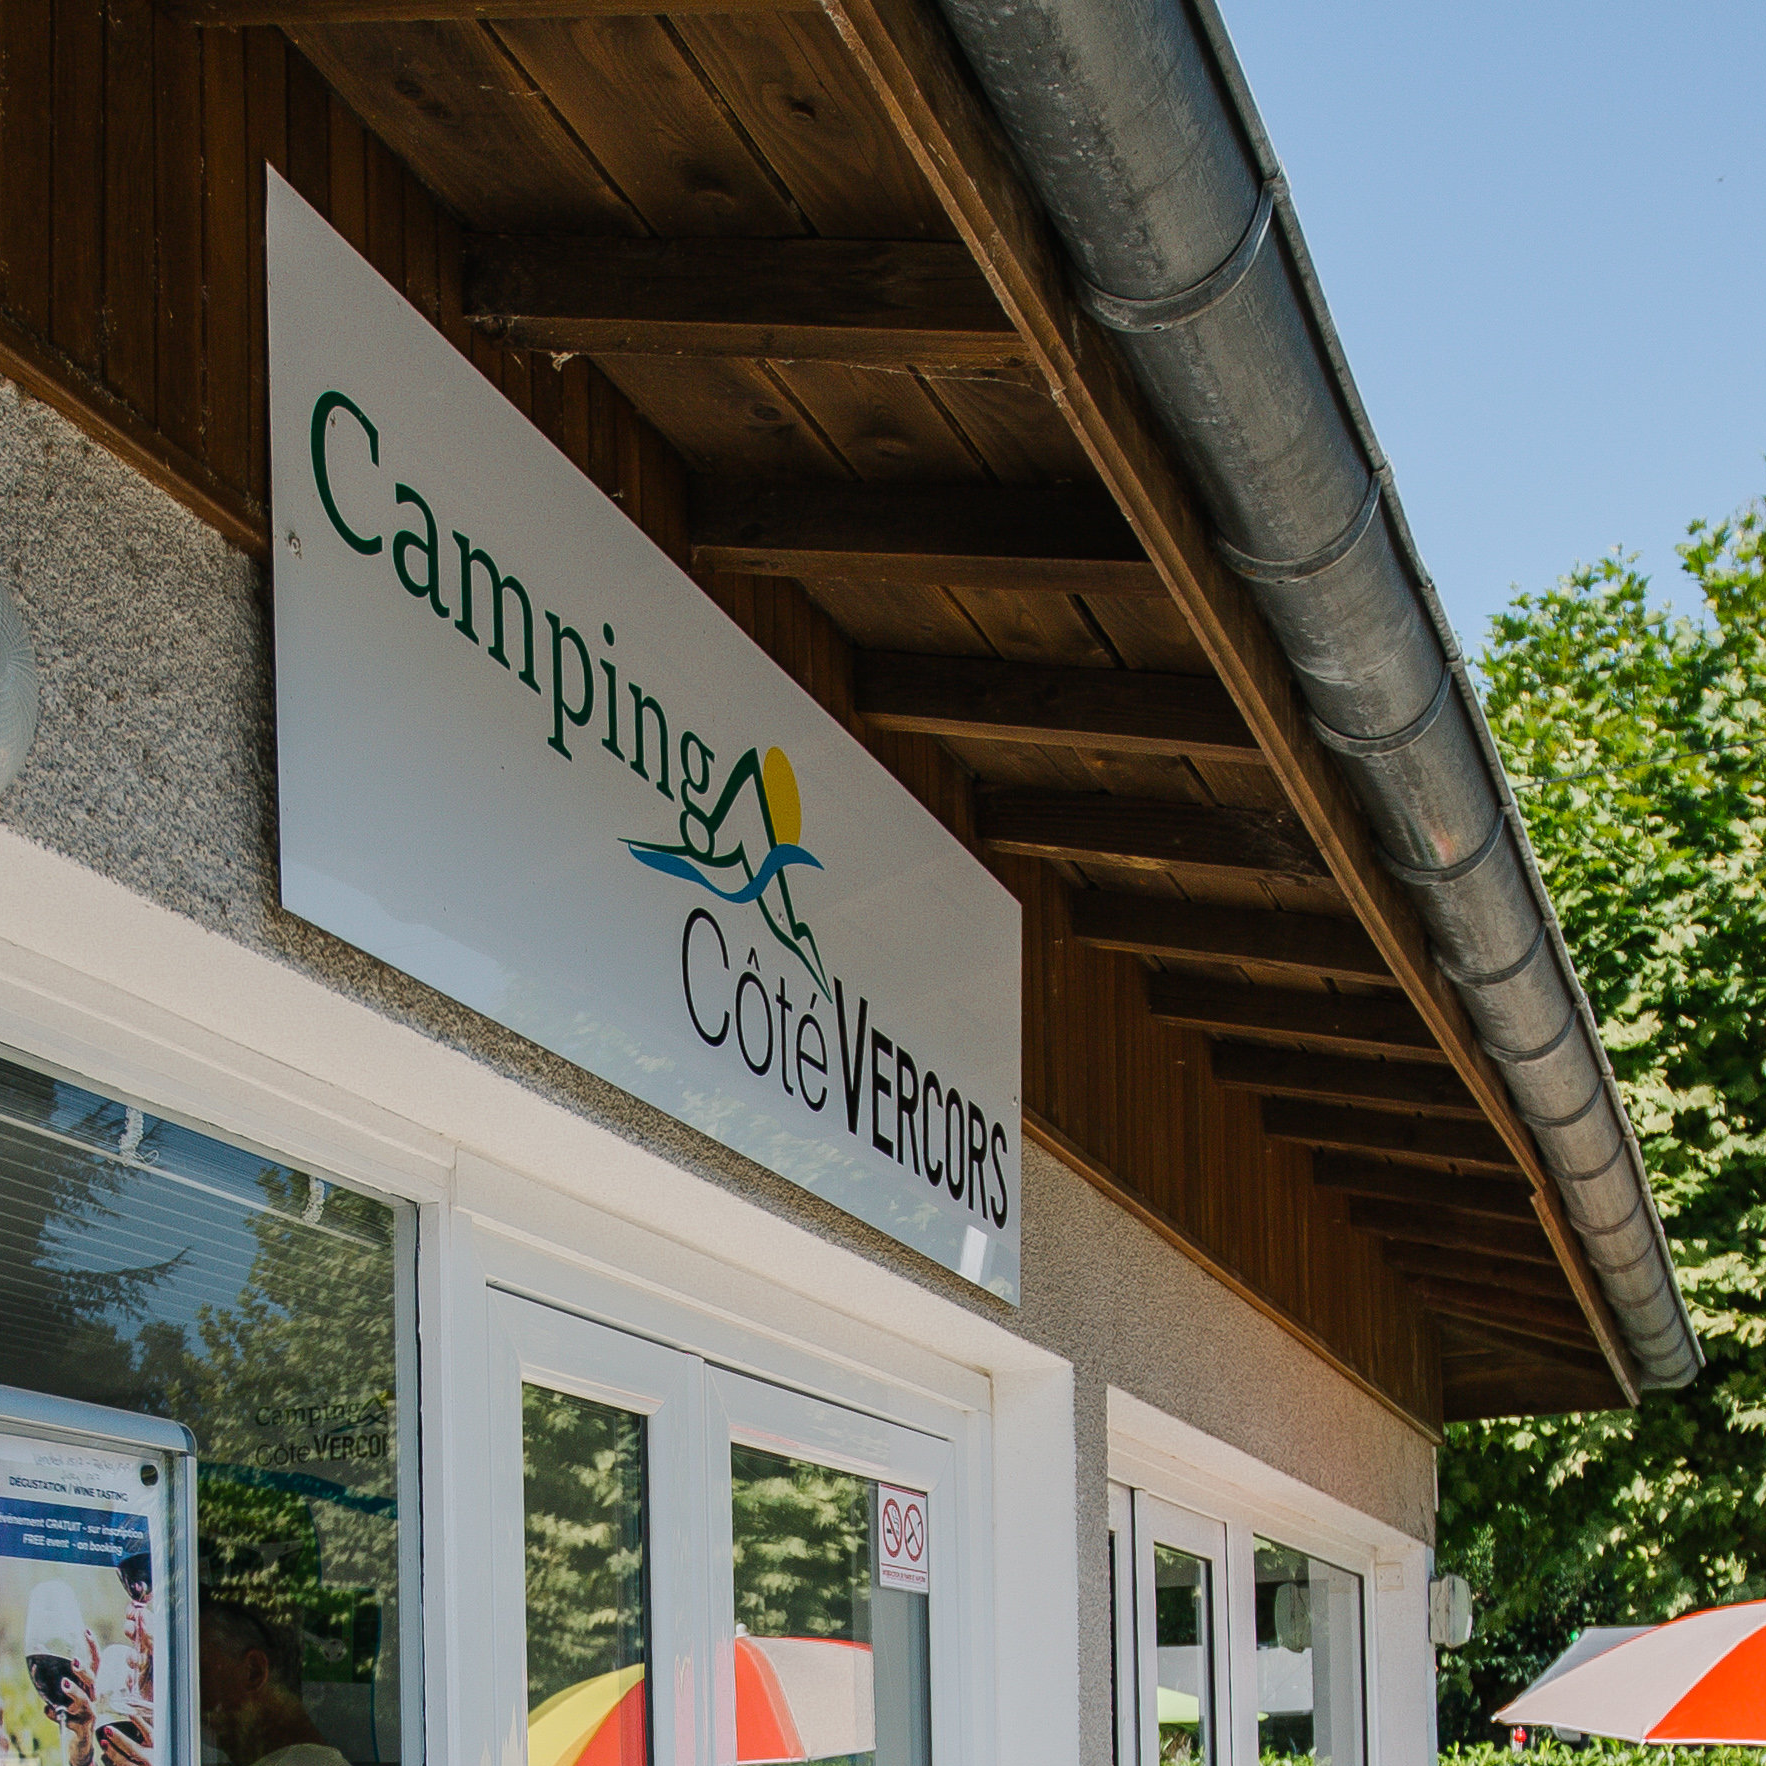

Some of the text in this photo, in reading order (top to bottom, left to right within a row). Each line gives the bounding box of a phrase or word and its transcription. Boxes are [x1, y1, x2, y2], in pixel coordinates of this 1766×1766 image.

[310, 389, 718, 856] Camping
[74, 1485, 95, 1497] WINE
[96, 1488, 128, 1502] TASTING
[46, 1518, 82, 1532] GRATUIT
[102, 1524, 144, 1540] inscription
[22, 1533, 46, 1546] FREE
[47, 1537, 70, 1549] event
[77, 1541, 89, 1551] on
[89, 1540, 123, 1557] booking
